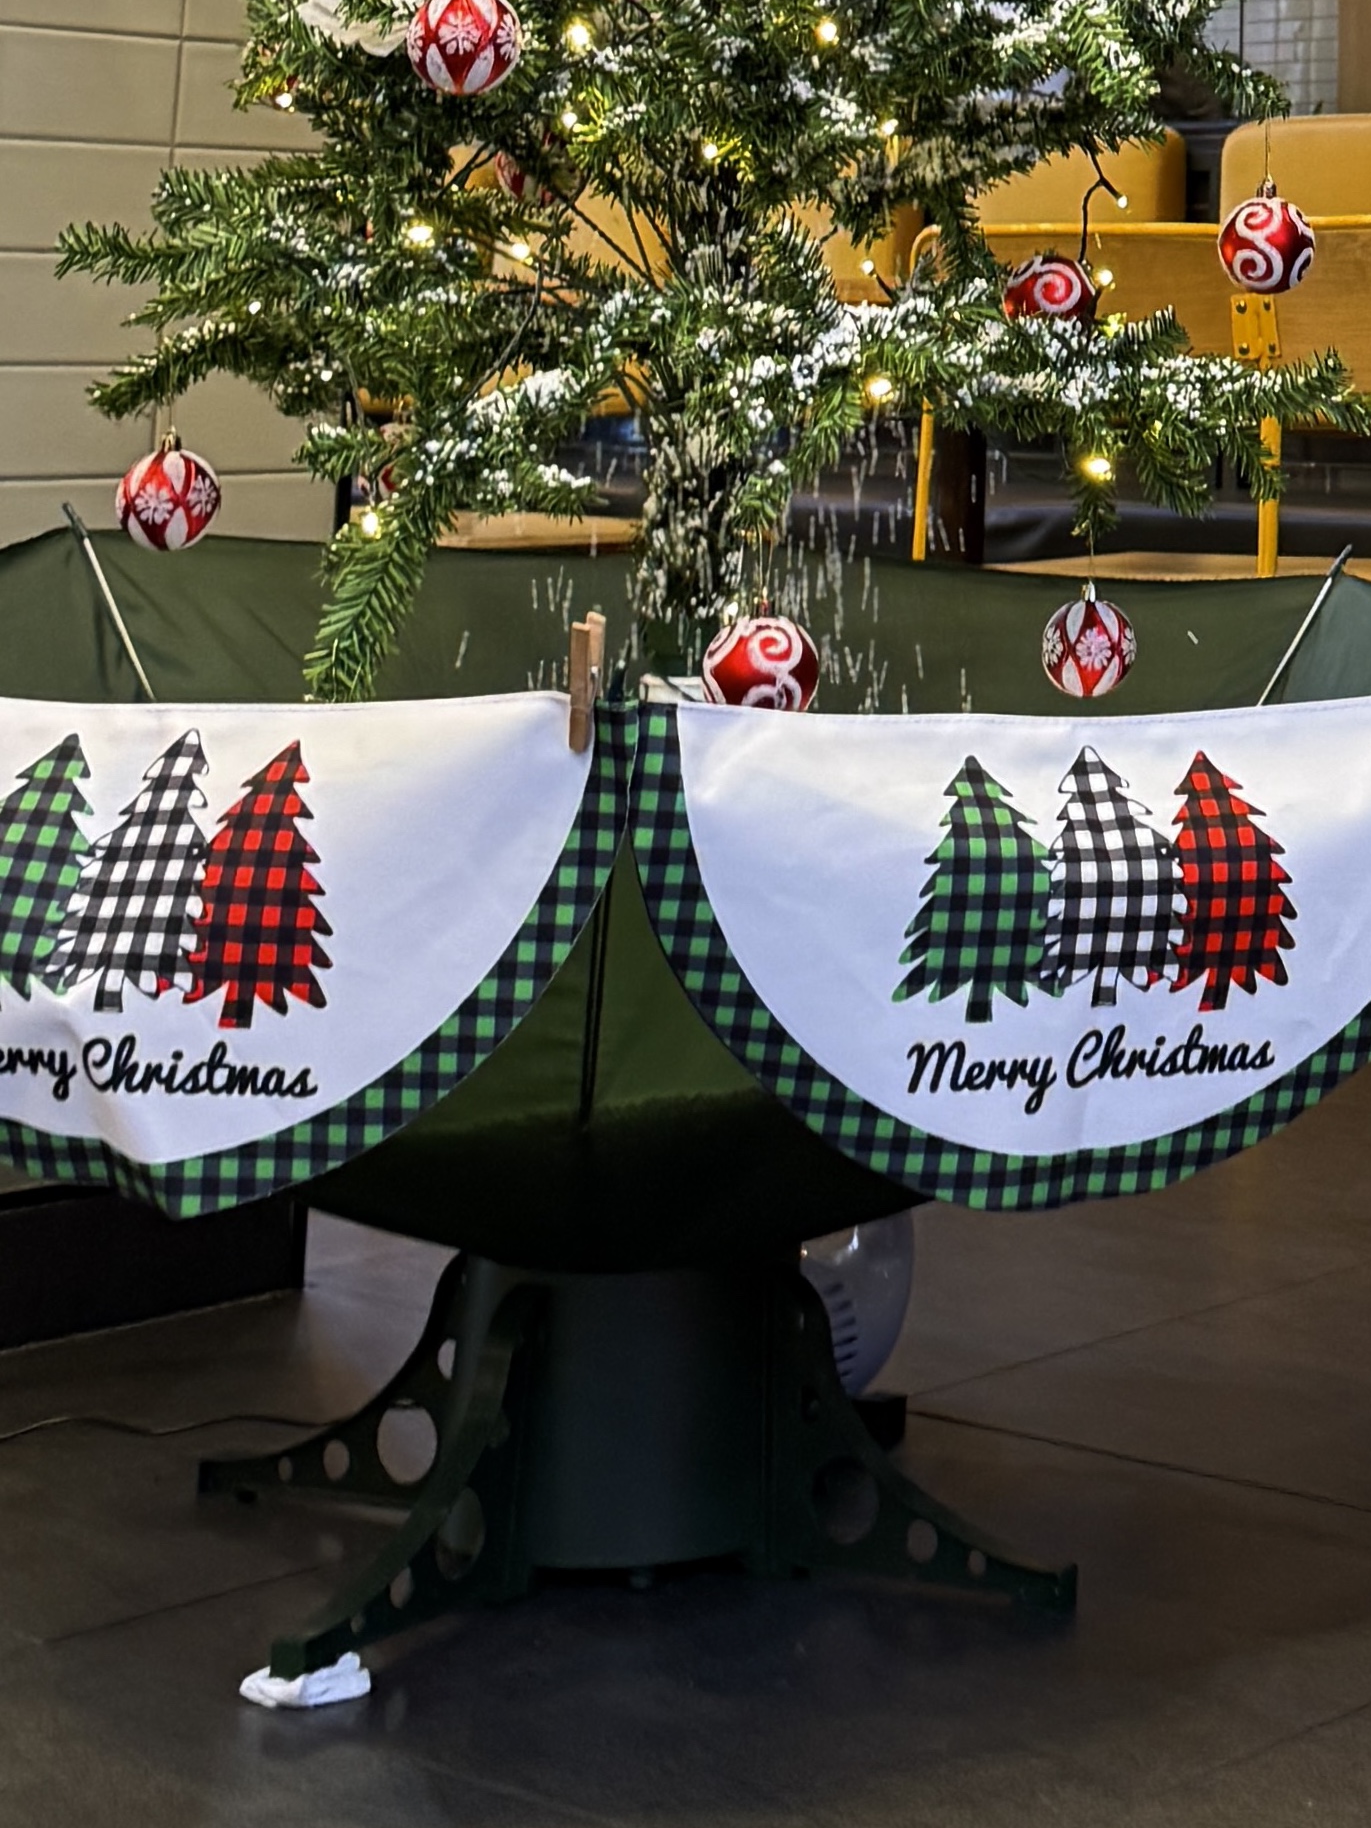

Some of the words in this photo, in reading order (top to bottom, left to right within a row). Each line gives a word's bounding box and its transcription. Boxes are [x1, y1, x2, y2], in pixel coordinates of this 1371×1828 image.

[82, 1034, 318, 1098] Christmas
[907, 1040, 1057, 1114] Merry
[1066, 1024, 1275, 1089] Christmas
